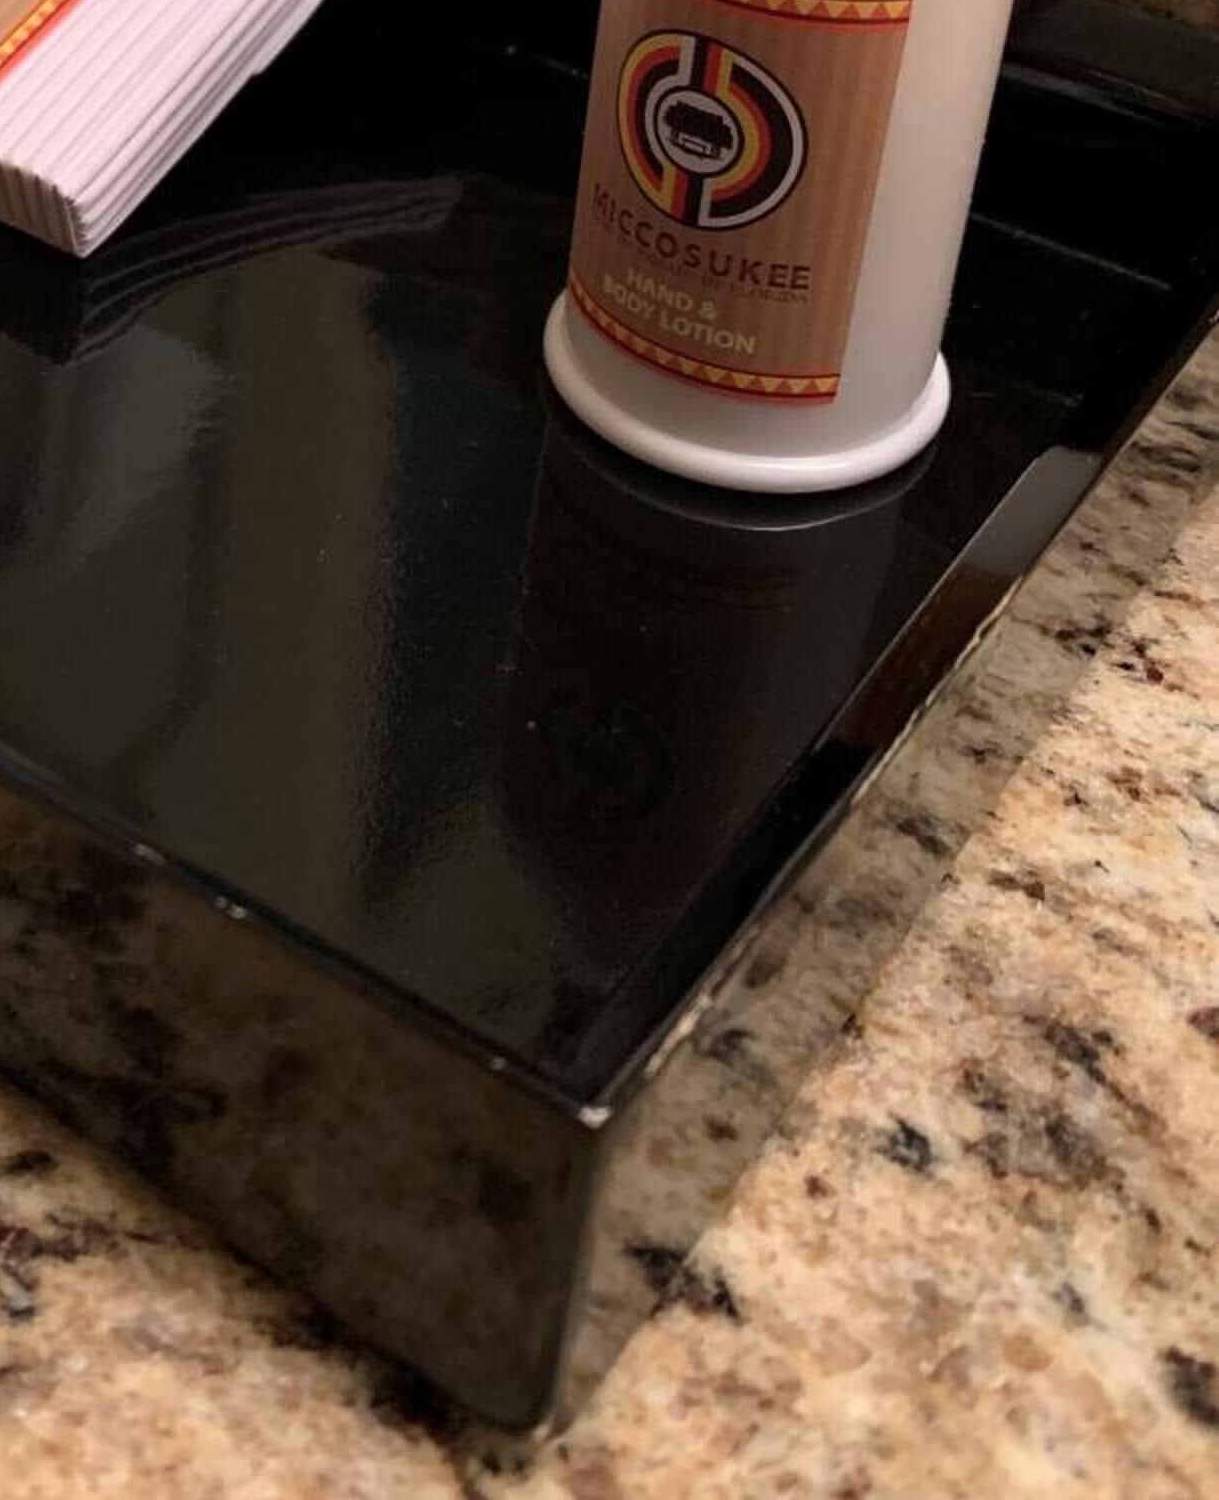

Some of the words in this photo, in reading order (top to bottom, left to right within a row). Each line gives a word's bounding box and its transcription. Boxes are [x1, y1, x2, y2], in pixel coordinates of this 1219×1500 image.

[593, 182, 811, 291] MICCOSUKEE
[601, 273, 655, 318] BODY
[660, 307, 758, 355] LOTION
[626, 268, 694, 312] HAND
[697, 299, 718, 321] &
